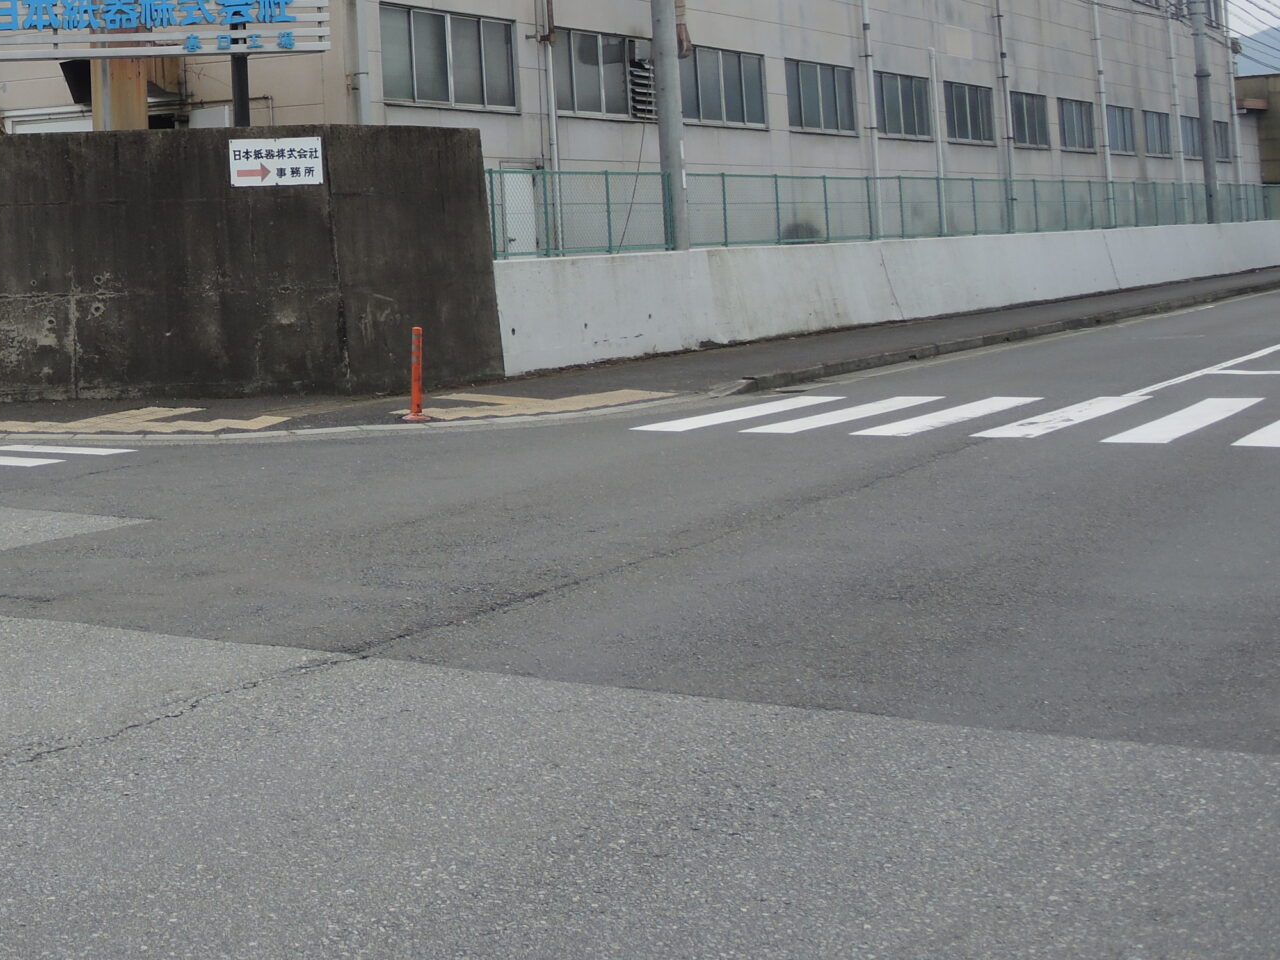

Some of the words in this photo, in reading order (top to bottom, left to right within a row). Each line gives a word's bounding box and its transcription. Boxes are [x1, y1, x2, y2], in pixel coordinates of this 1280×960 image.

[183, 32, 295, 53] 春日工場
[232, 147, 320, 161] 日本紙器株式会社
[276, 166, 316, 179] 事務所
